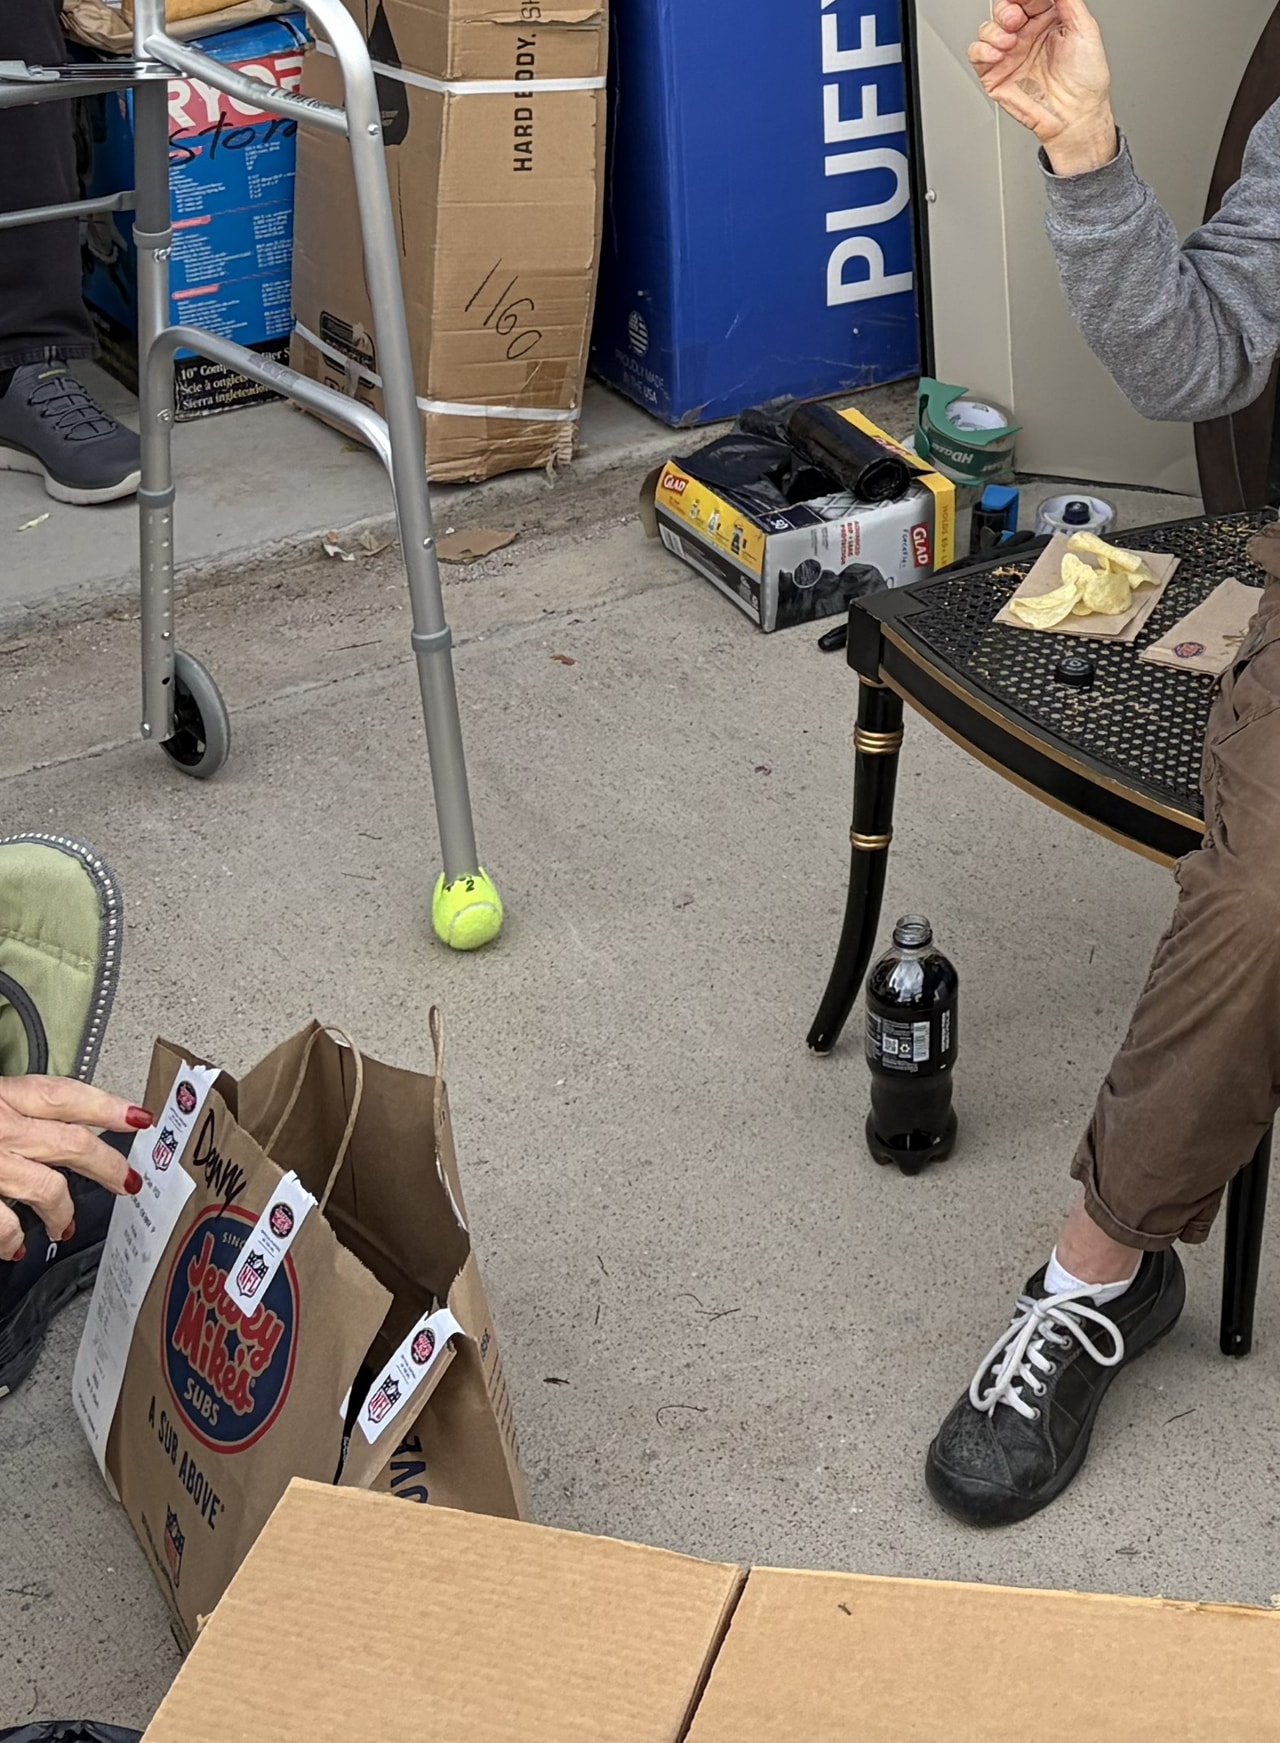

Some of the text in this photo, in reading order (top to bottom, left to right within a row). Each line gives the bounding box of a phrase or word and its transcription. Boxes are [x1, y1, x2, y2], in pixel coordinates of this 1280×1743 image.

[513, 107, 533, 172] HARD
[181, 380, 203, 396] Scie
[182, 394, 214, 411] Sierra
[643, 387, 658, 403] USA
[663, 474, 687, 493] GLAD
[912, 526, 929, 566] GLAD
[187, 1231, 285, 1366] Jersey
[237, 1269, 259, 1295] NFL
[173, 1294, 254, 1416] Mike's
[183, 1376, 221, 1427] SUBS
[148, 1395, 221, 1531] A SUB ABOVE
